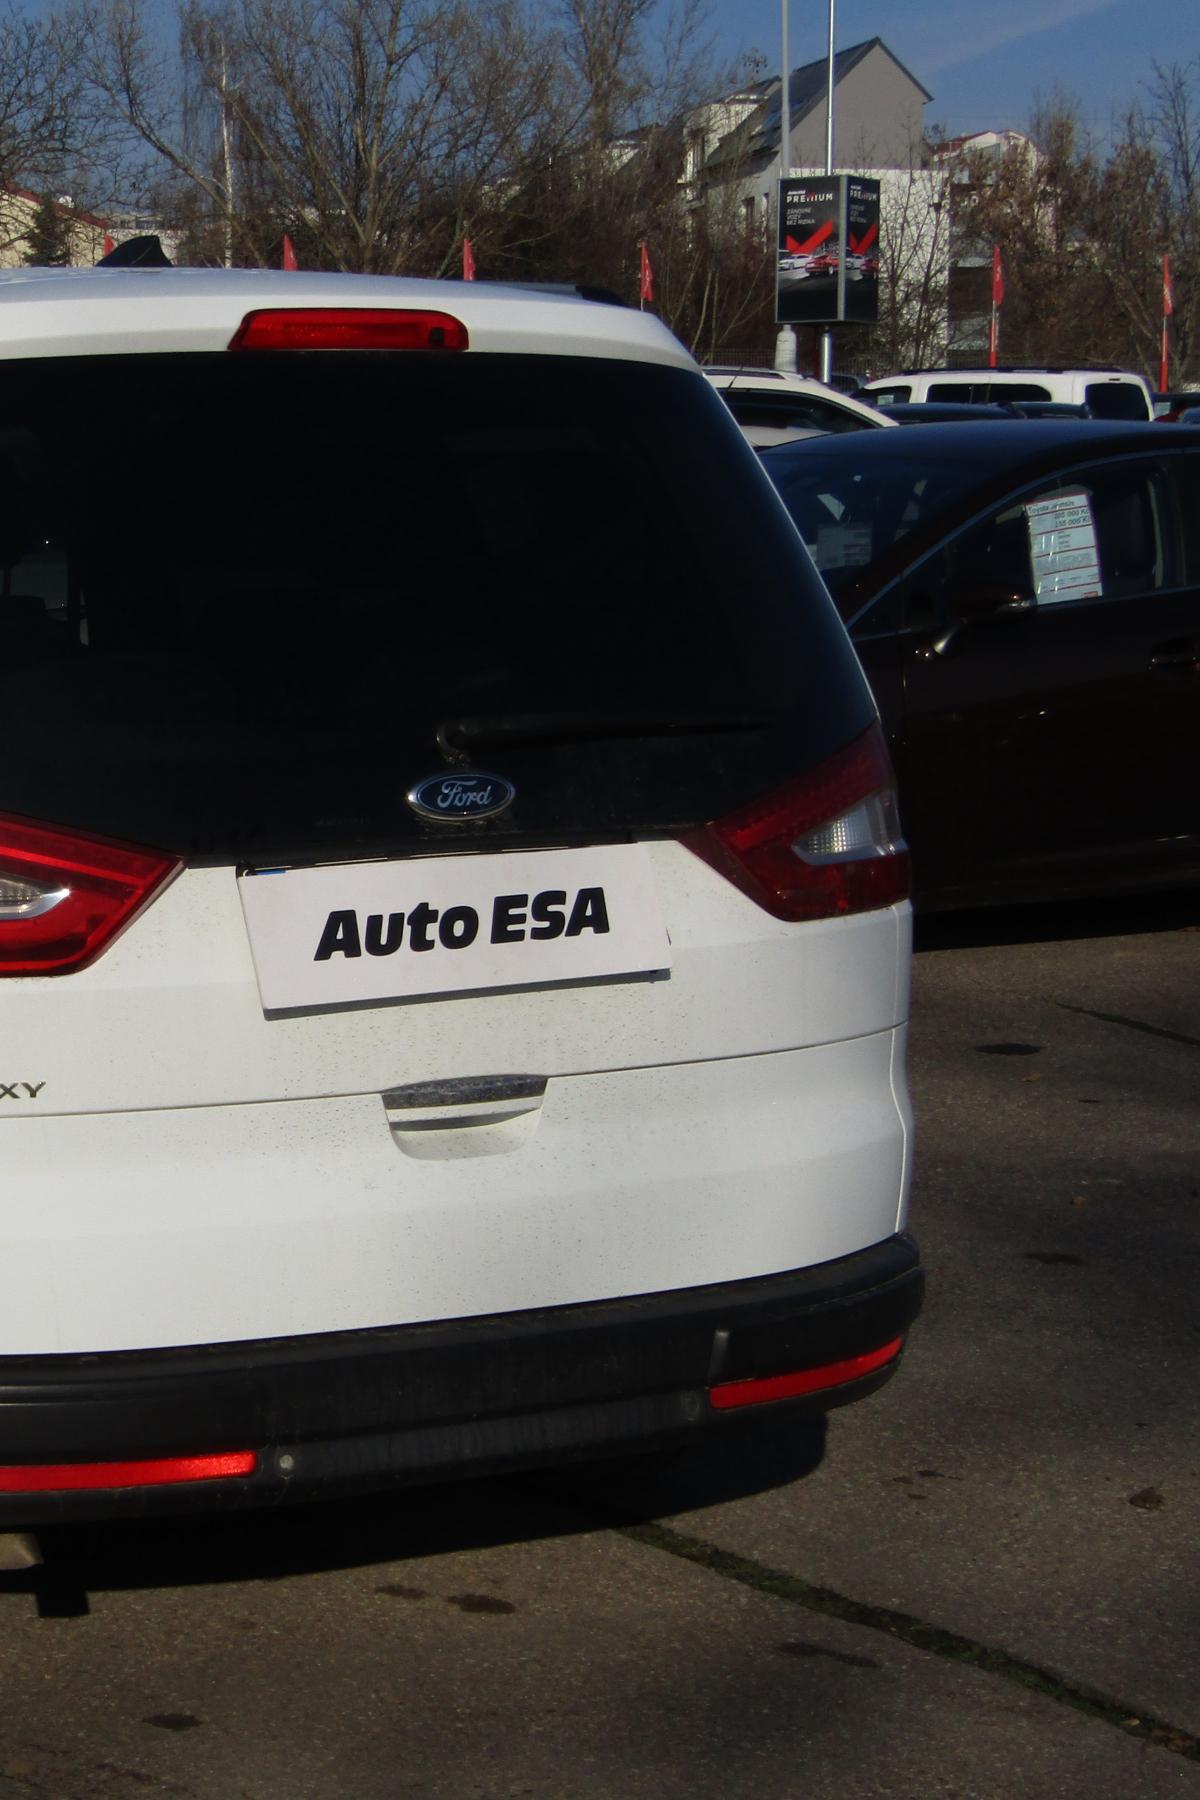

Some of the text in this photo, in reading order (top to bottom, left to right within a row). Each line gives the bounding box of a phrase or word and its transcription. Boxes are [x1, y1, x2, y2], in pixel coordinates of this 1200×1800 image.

[437, 780, 492, 808] Ford
[313, 887, 610, 961] Auto ESA
